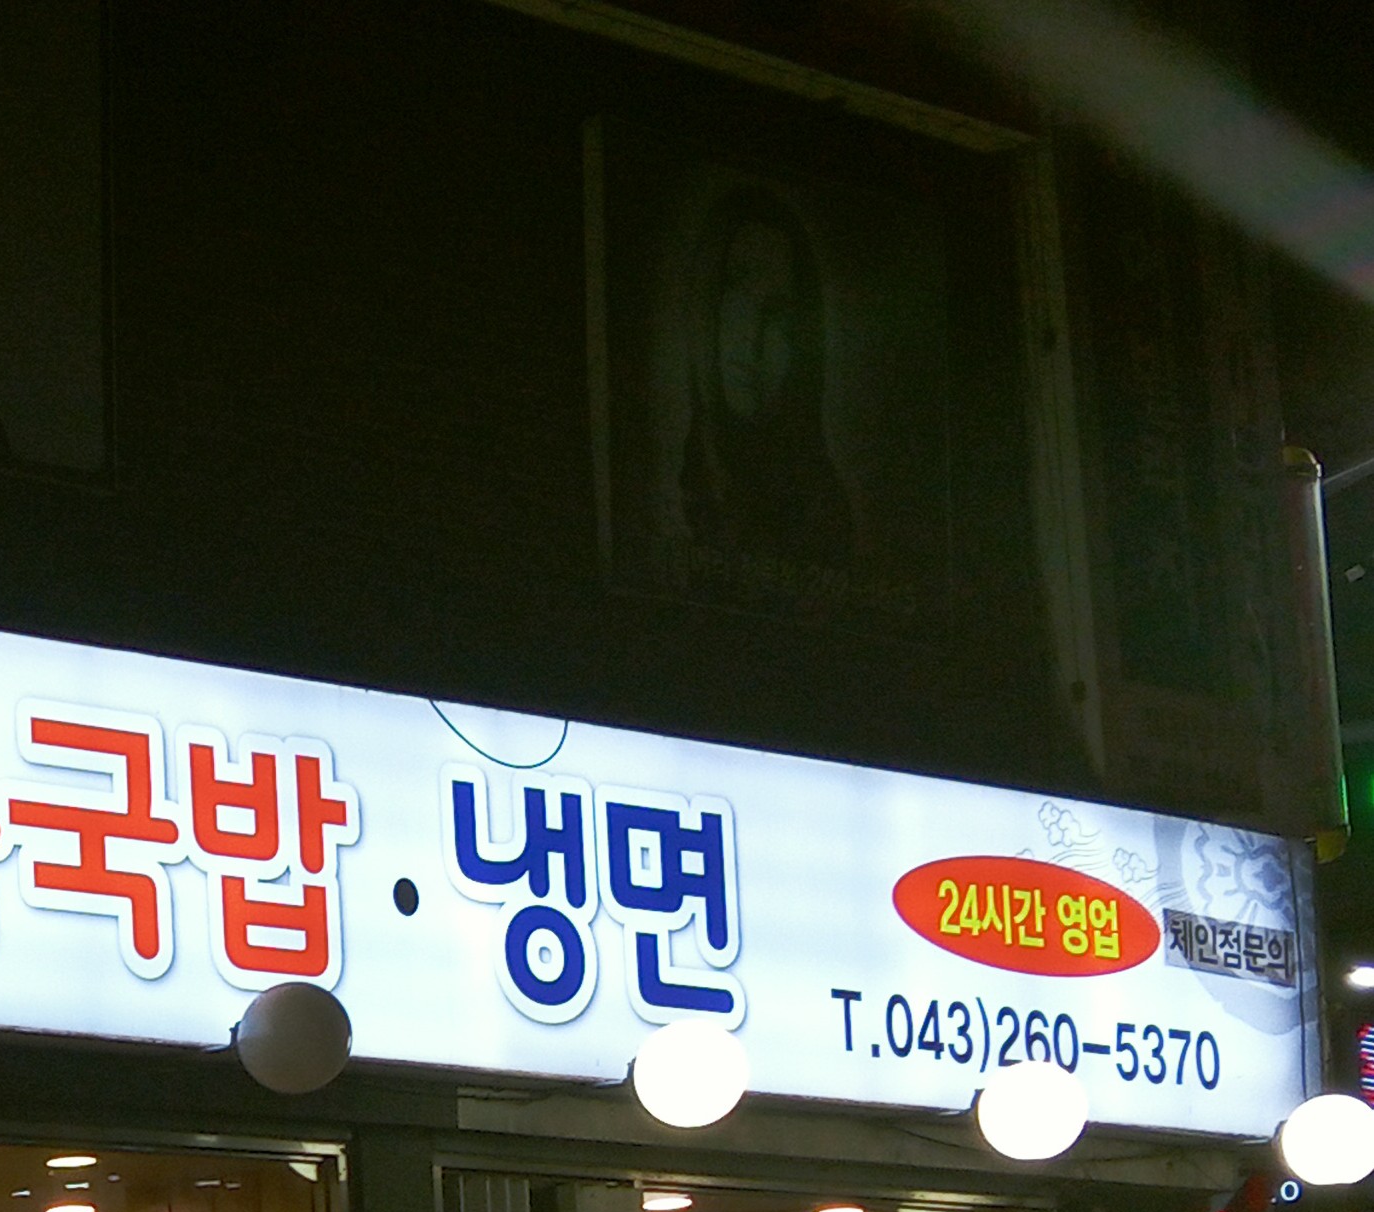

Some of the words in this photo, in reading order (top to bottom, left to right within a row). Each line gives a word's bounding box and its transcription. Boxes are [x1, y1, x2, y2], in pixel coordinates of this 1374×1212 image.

[451, 779, 736, 1015] 냉면
[938, 880, 1046, 948] 24시간
[1057, 895, 1121, 960] 영업
[1169, 914, 1295, 981] 체인점문의
